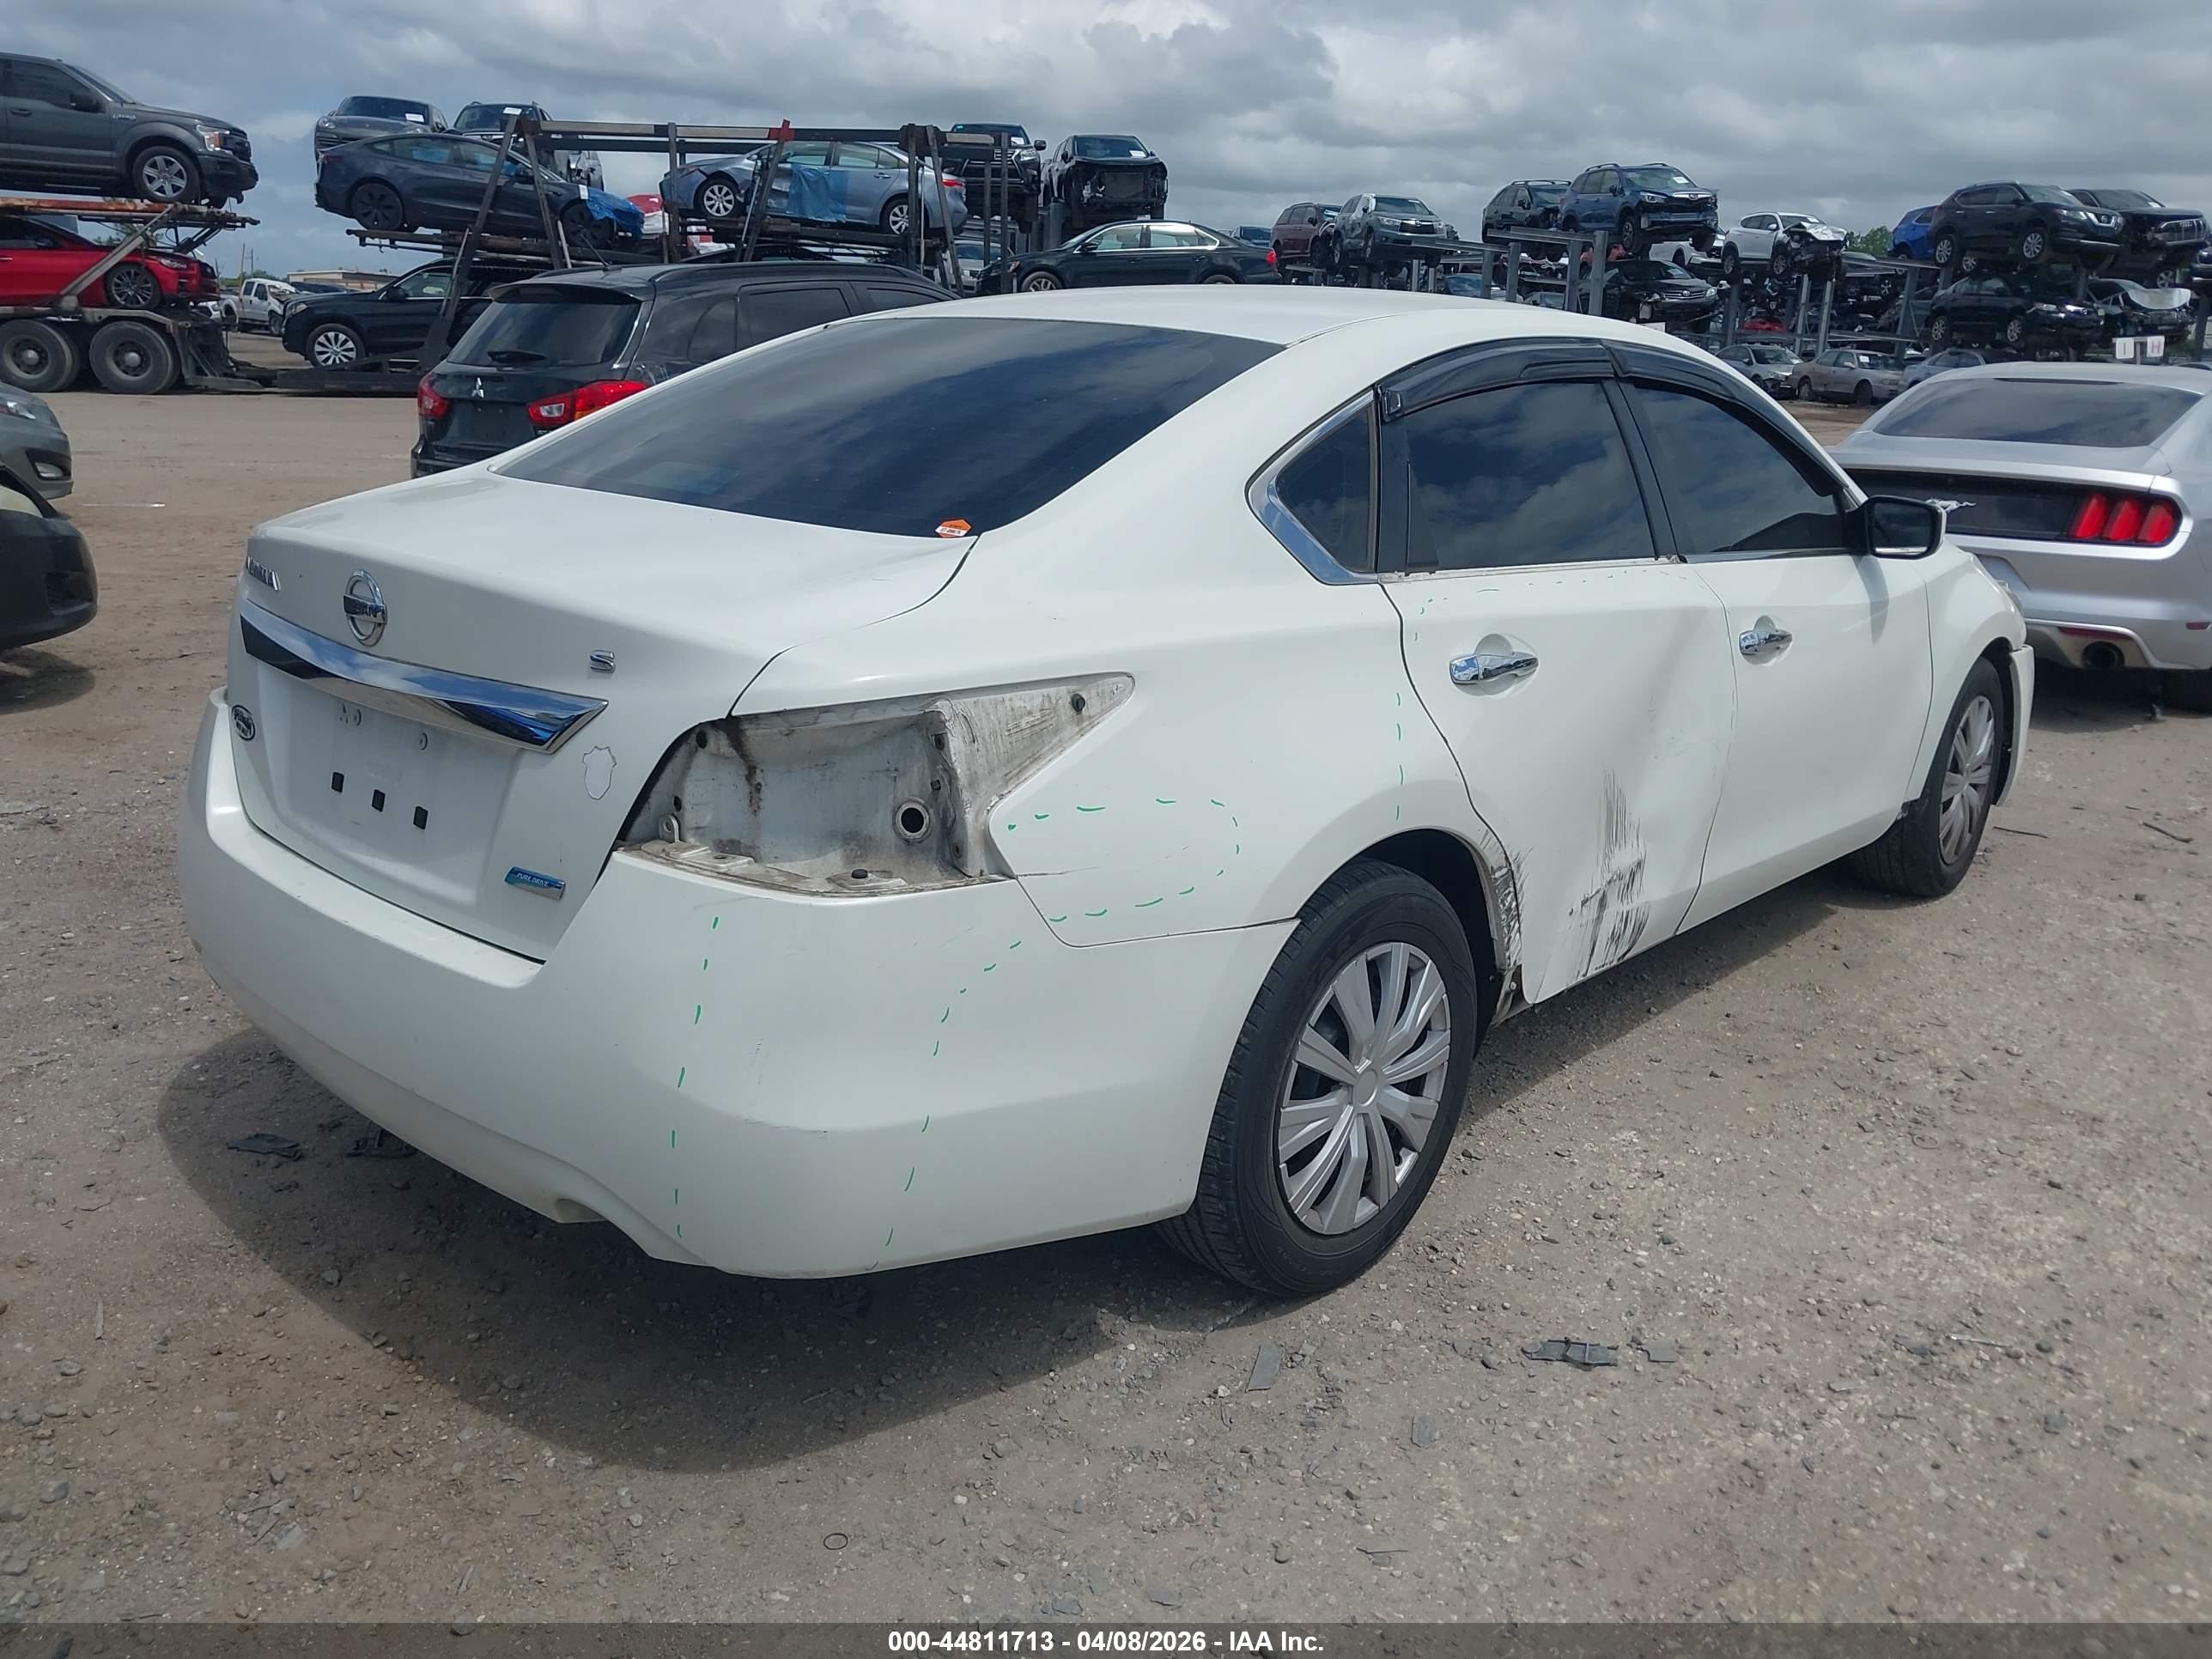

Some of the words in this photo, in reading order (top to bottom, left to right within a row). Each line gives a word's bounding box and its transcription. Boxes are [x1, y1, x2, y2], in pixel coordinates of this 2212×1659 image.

[2151, 340, 2161, 354] H
[590, 650, 616, 674] S
[517, 872, 532, 882] PURE
[532, 877, 550, 887] DRIVE
